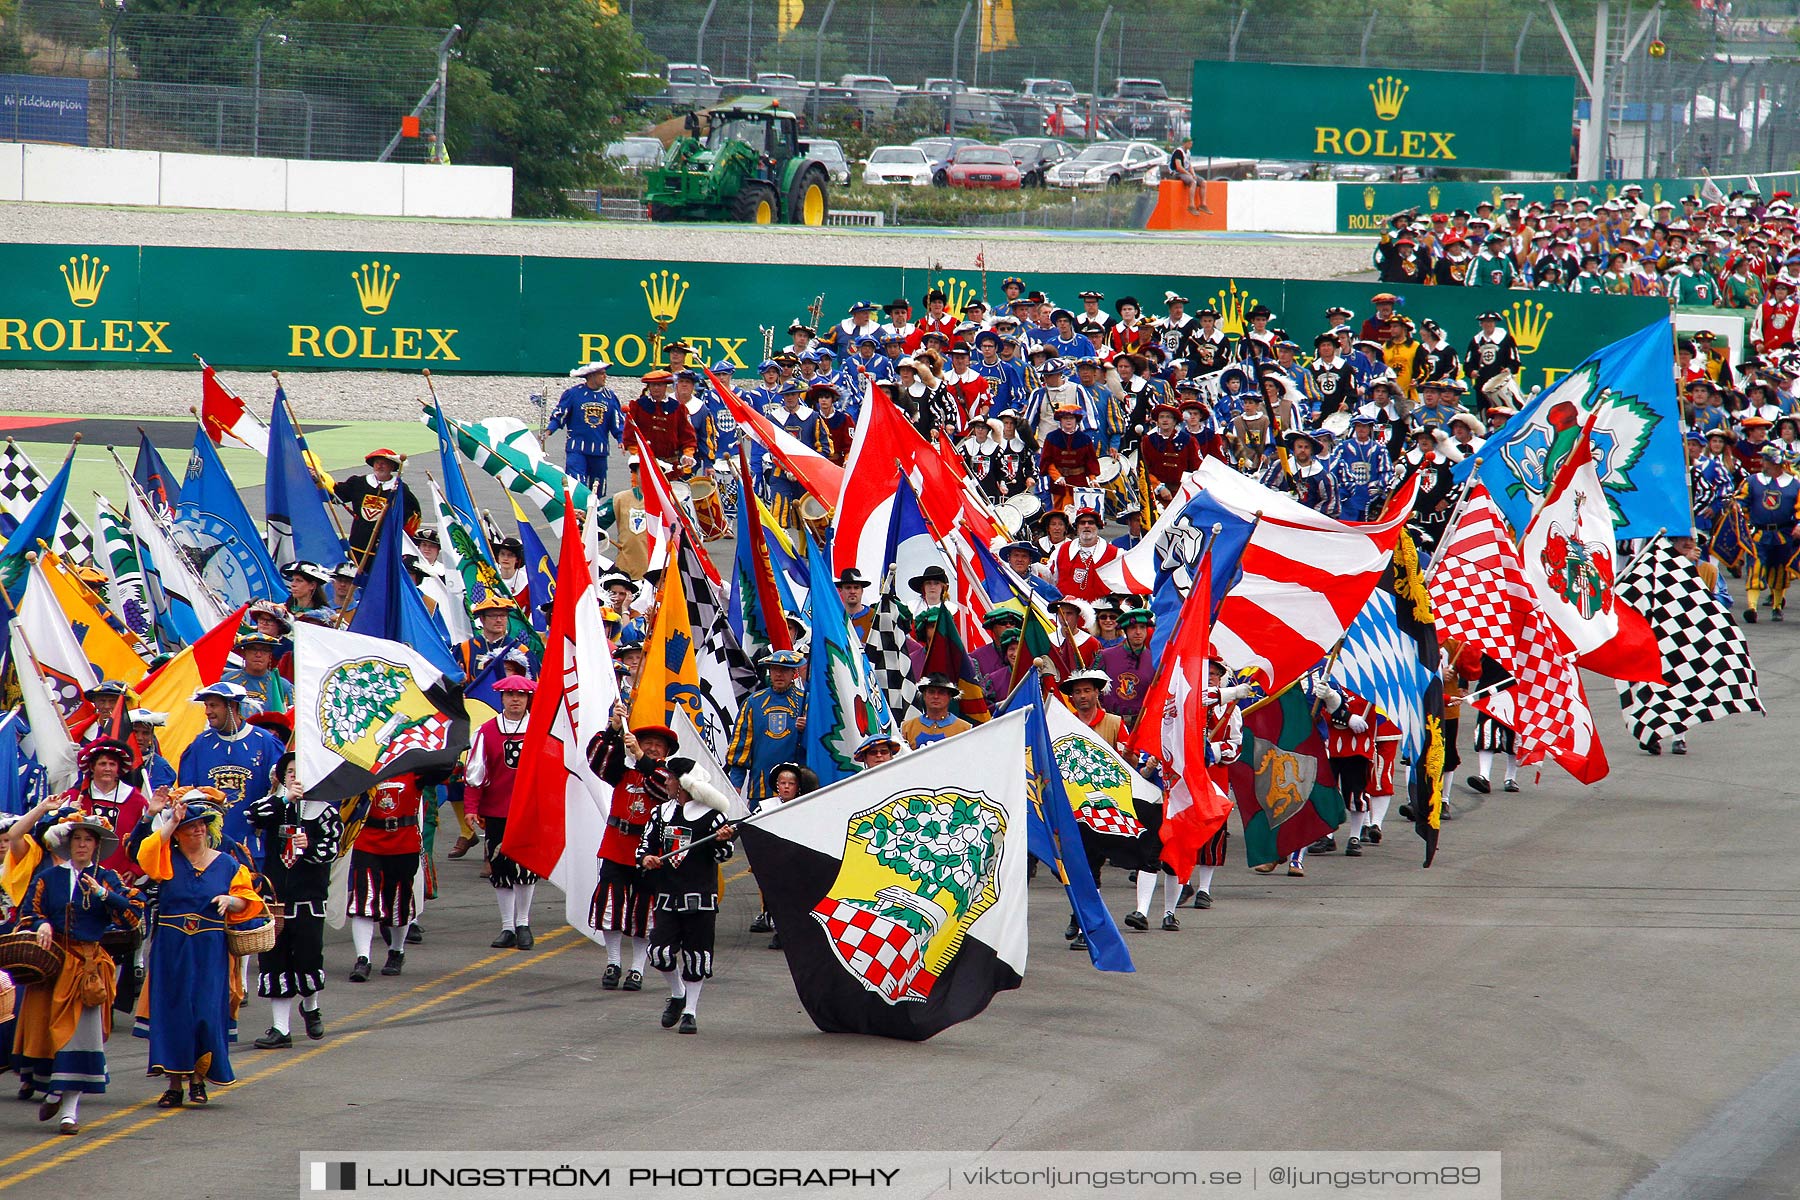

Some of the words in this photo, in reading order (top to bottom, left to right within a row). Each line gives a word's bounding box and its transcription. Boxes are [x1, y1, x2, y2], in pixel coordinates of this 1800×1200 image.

[4, 94, 82, 116] Wrldchampion
[1313, 126, 1457, 160] ROLEX
[0, 318, 173, 353] ROLEX
[287, 324, 461, 361] ROLEX
[577, 333, 749, 369] ROLEX
